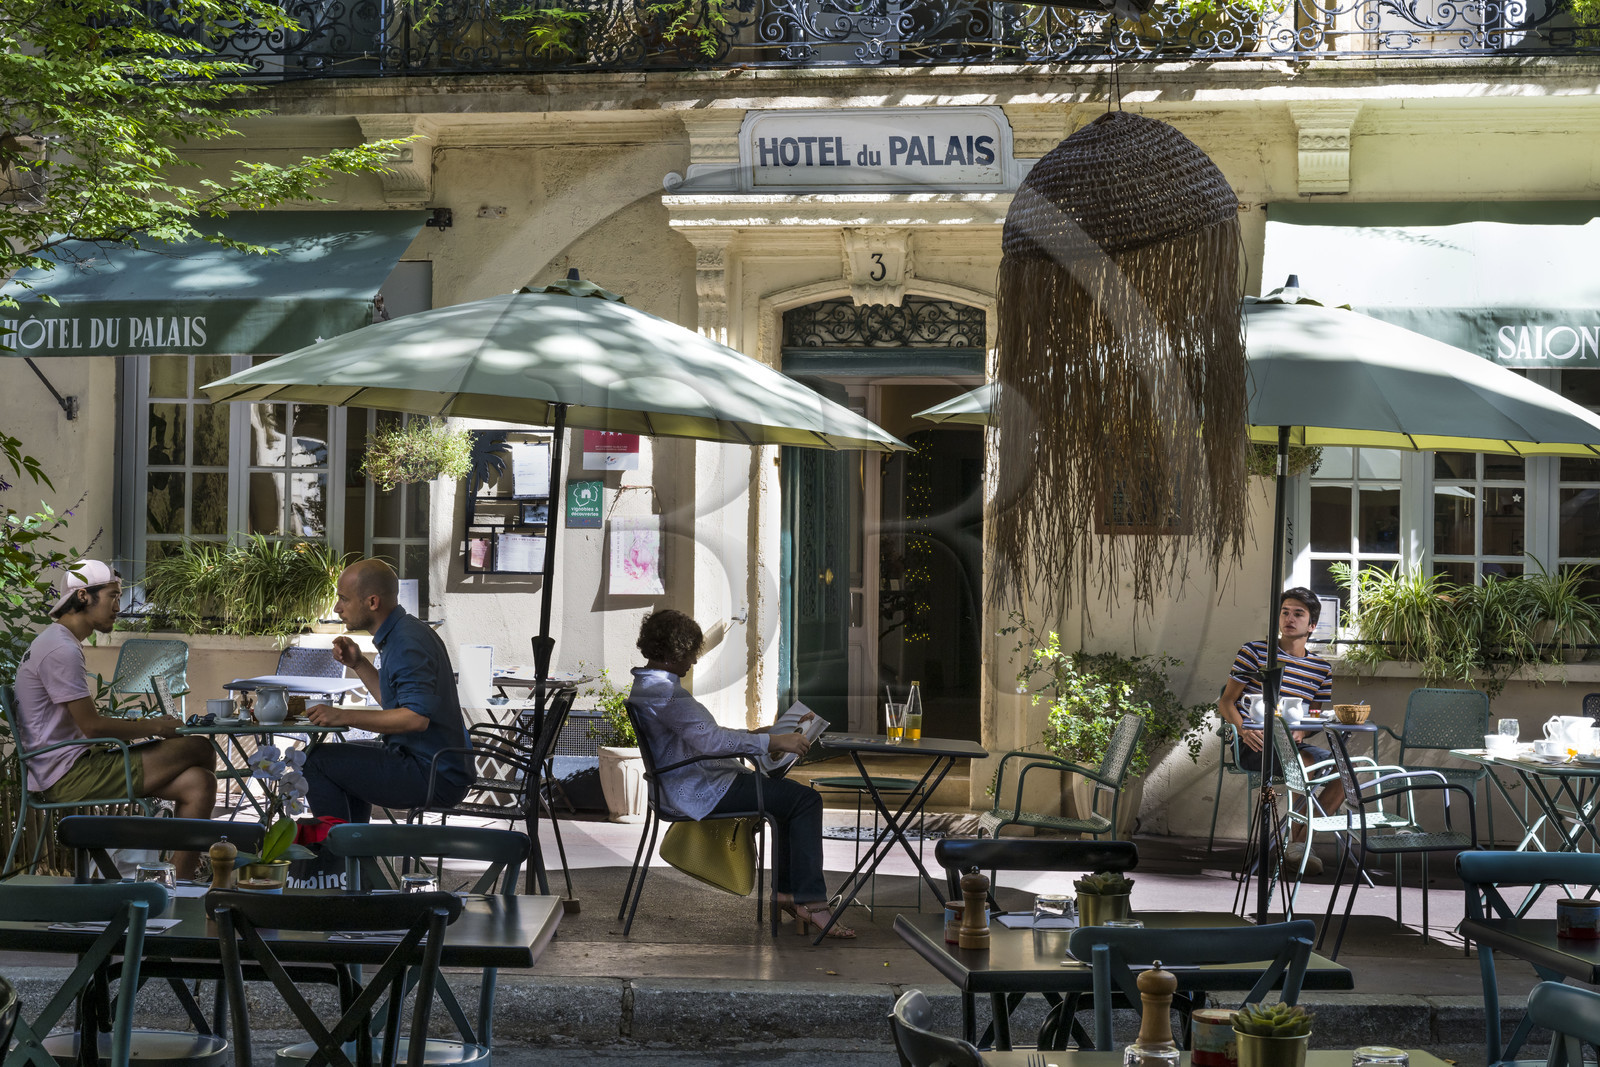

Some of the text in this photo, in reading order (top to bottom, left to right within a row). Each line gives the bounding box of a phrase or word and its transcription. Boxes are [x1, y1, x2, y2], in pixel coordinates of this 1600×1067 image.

[758, 135, 995, 167] HOTEL du PALAIS
[870, 253, 887, 282] 3
[3, 314, 207, 349] HÔTEL DU PALAIS
[1499, 325, 1600, 359] SALON
